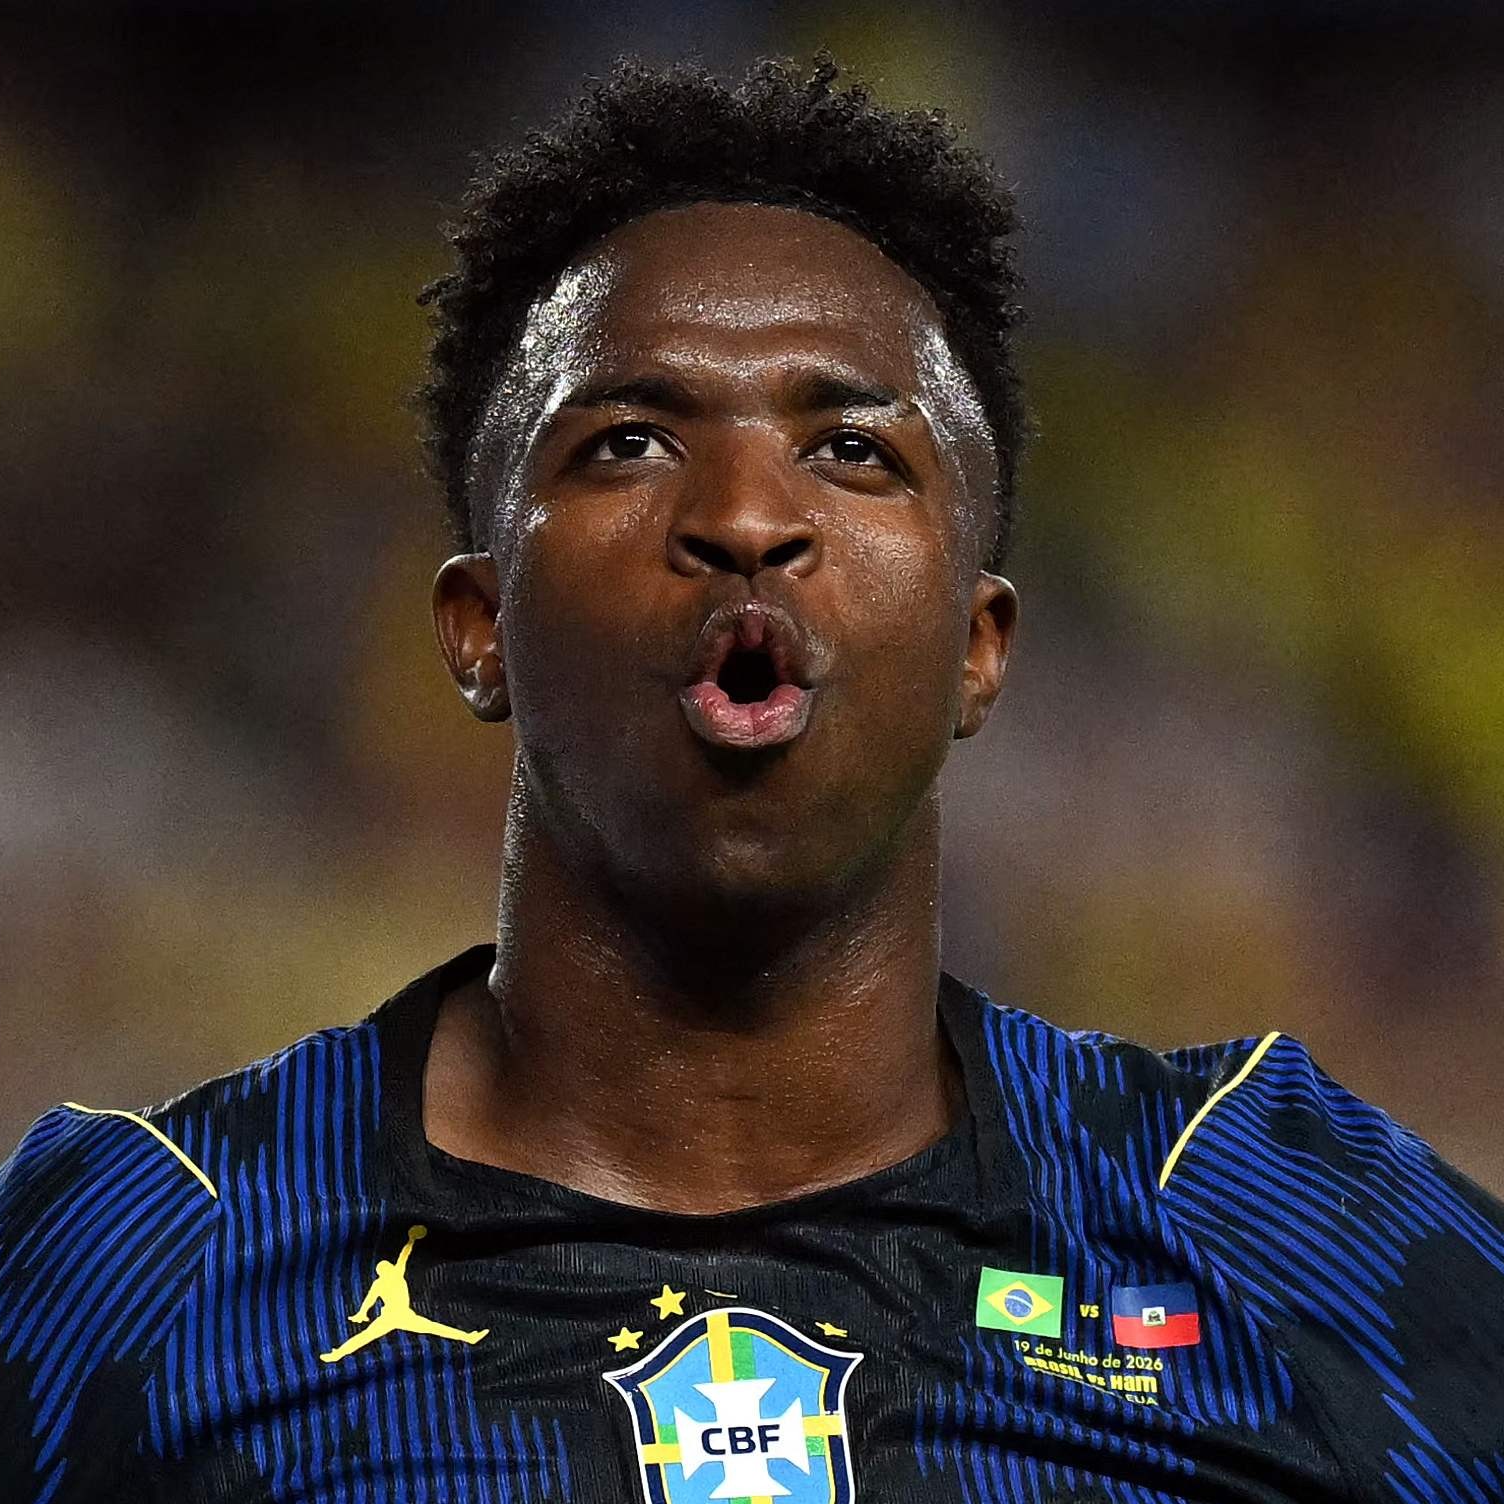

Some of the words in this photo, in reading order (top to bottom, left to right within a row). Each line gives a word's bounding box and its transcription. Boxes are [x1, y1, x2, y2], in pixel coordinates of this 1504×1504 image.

[1014, 1340, 1031, 1353] 19
[1035, 1344, 1053, 1357] de
[1058, 1347, 1099, 1366] Junho
[1102, 1353, 1122, 1368] de
[1125, 1354, 1164, 1371] 2026
[700, 1423, 781, 1457] CBF
